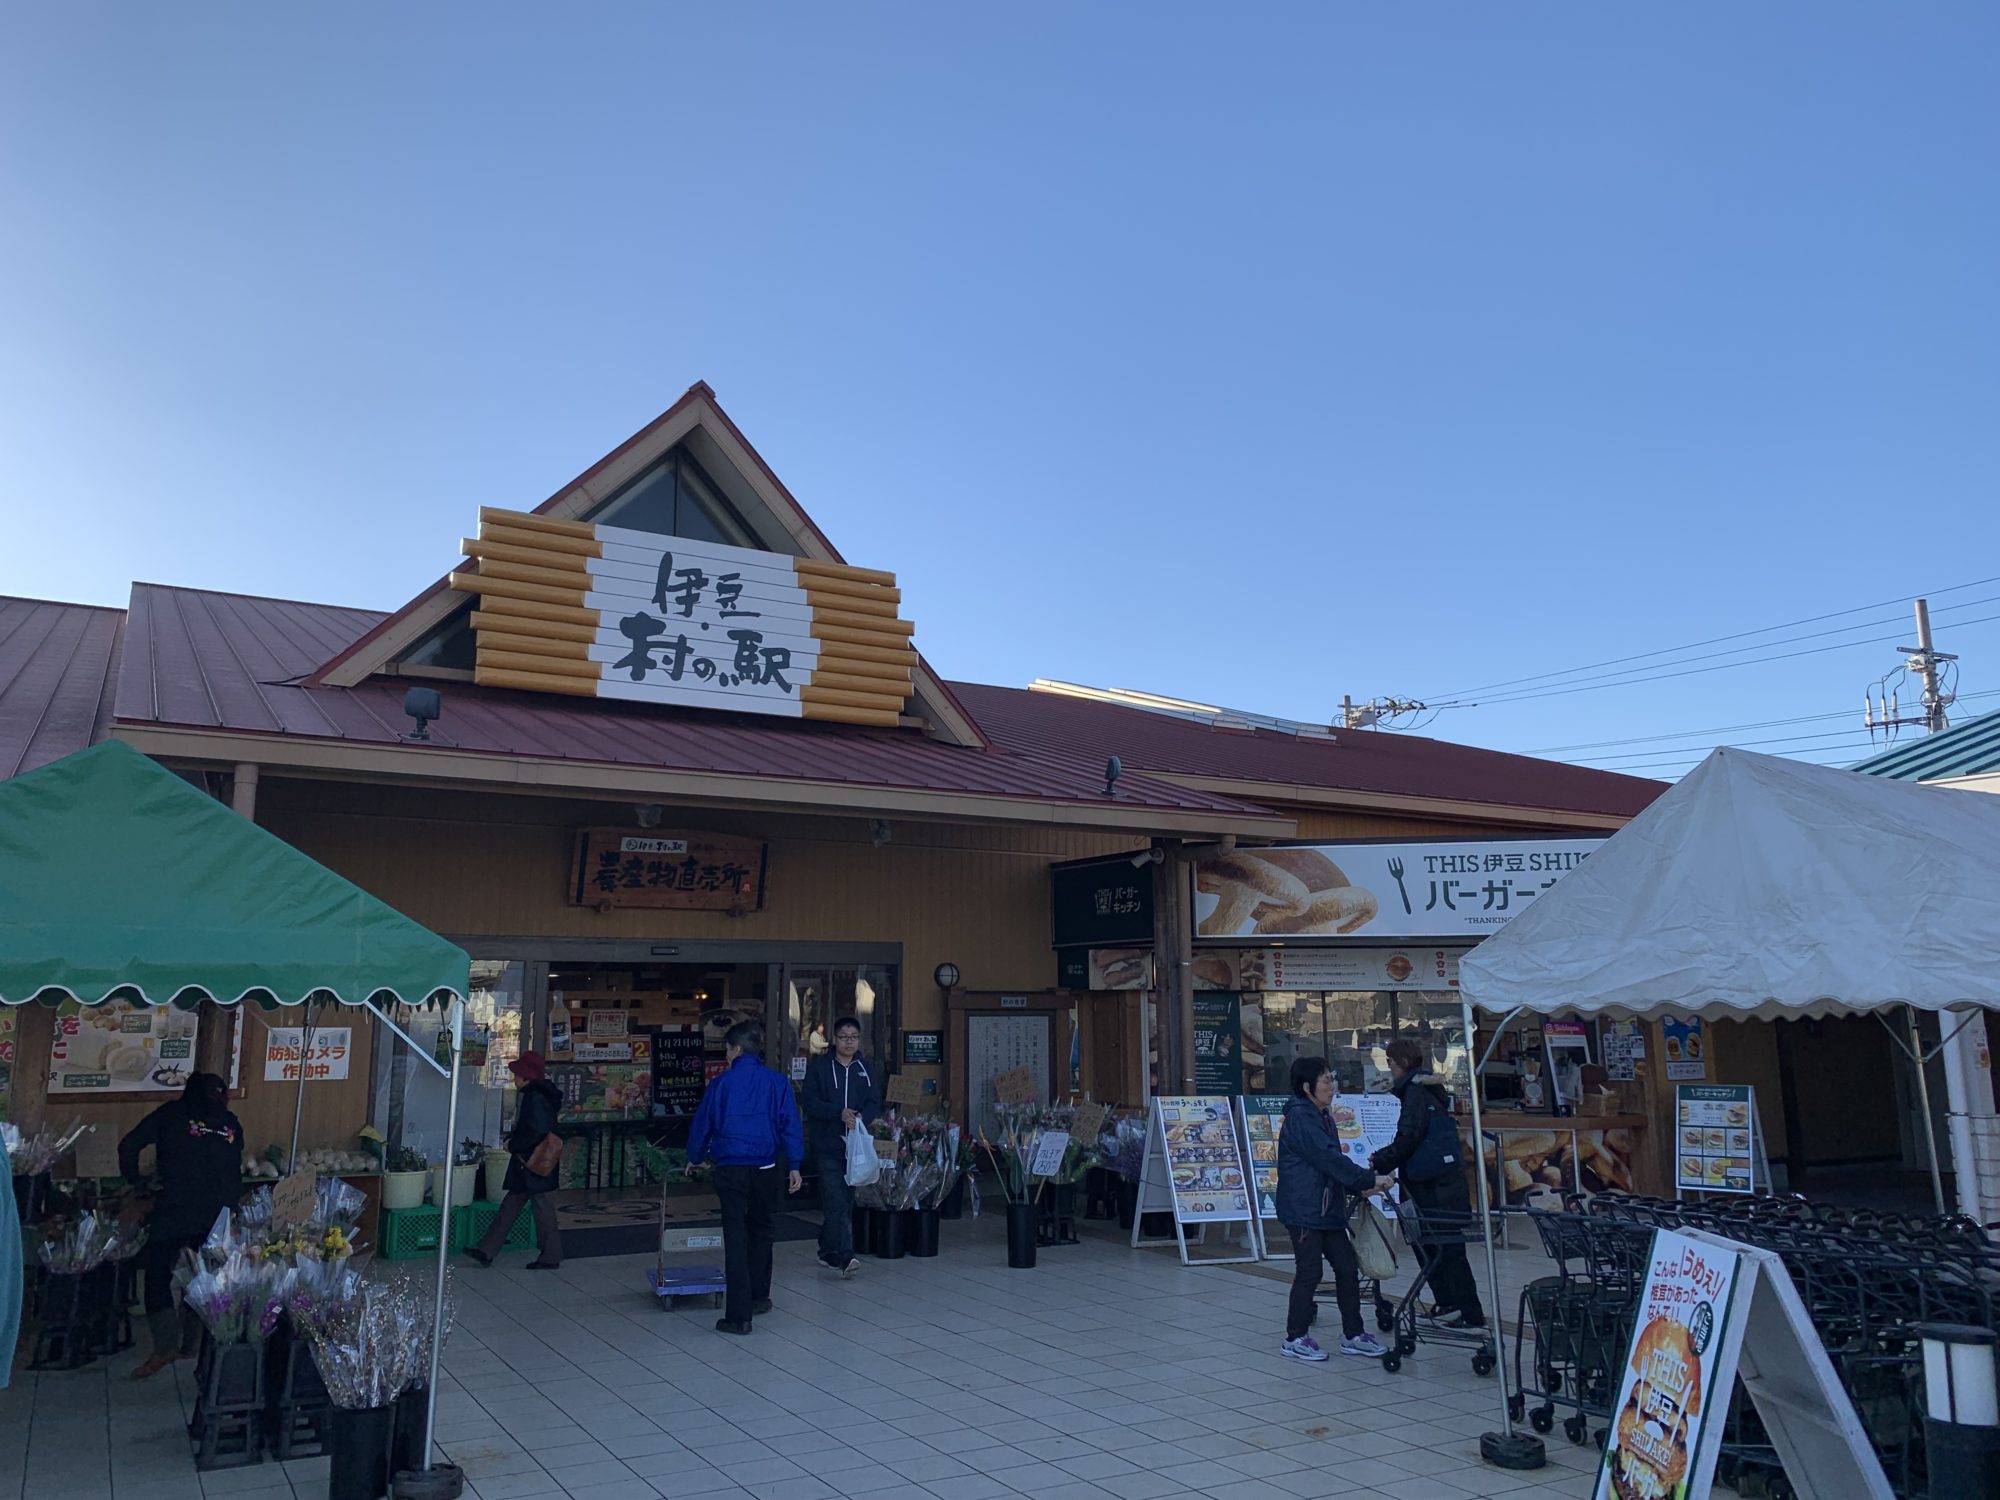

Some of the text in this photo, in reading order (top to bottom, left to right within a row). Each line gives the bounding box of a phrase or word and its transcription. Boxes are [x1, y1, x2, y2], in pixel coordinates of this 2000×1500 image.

[612, 611, 793, 694] 村の駅
[592, 850, 750, 895] 農産物直売所
[1114, 886, 1139, 900] バーガー
[1113, 900, 1141, 913] キッチン
[267, 1046, 346, 1061] 防犯カメラ
[1654, 1260, 1678, 1278] こんな
[1650, 1283, 1699, 1304] 椎茸があった
[1648, 1348, 1689, 1393] THIS
